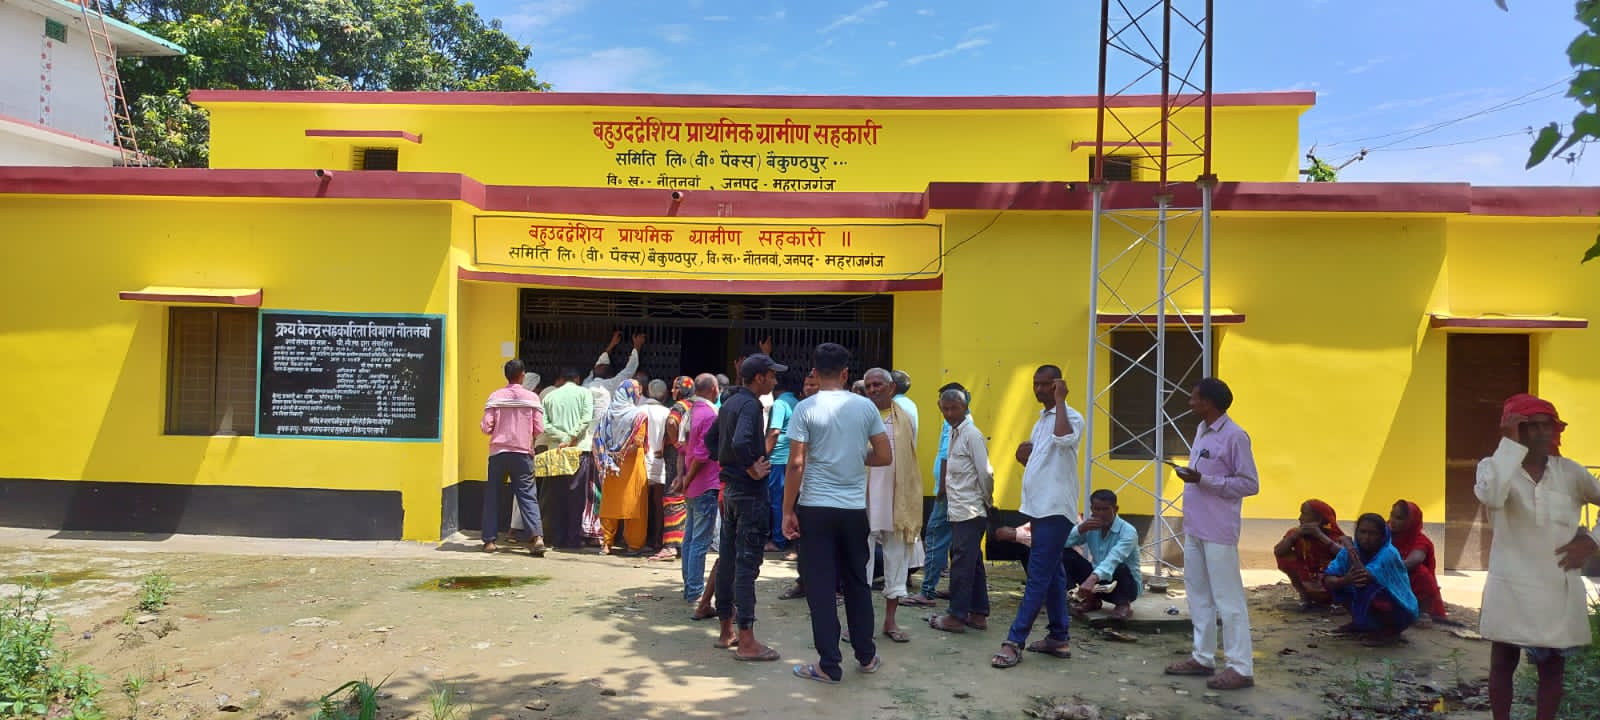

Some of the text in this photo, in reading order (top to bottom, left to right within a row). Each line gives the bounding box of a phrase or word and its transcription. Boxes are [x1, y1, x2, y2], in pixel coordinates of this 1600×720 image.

[685, 117, 753, 143] प्राथमिक
[756, 118, 811, 144] ग्रामीण
[814, 119, 882, 148] सहकारी
[616, 150, 656, 167] समिति
[767, 151, 829, 173] बैकुण्ठपुर
[722, 177, 758, 190] जनपद
[773, 177, 836, 191] महराजगंज
[618, 225, 674, 244] प्राथमिक
[689, 226, 742, 246] ग्रामीण
[758, 227, 825, 249] सहकारी
[509, 244, 552, 262] समिति
[825, 253, 885, 270] महराजगंज
[275, 322, 296, 338] क्रय
[297, 320, 321, 339] केन्द्र
[321, 321, 367, 338] सहकारिता
[368, 321, 395, 338] विभाग
